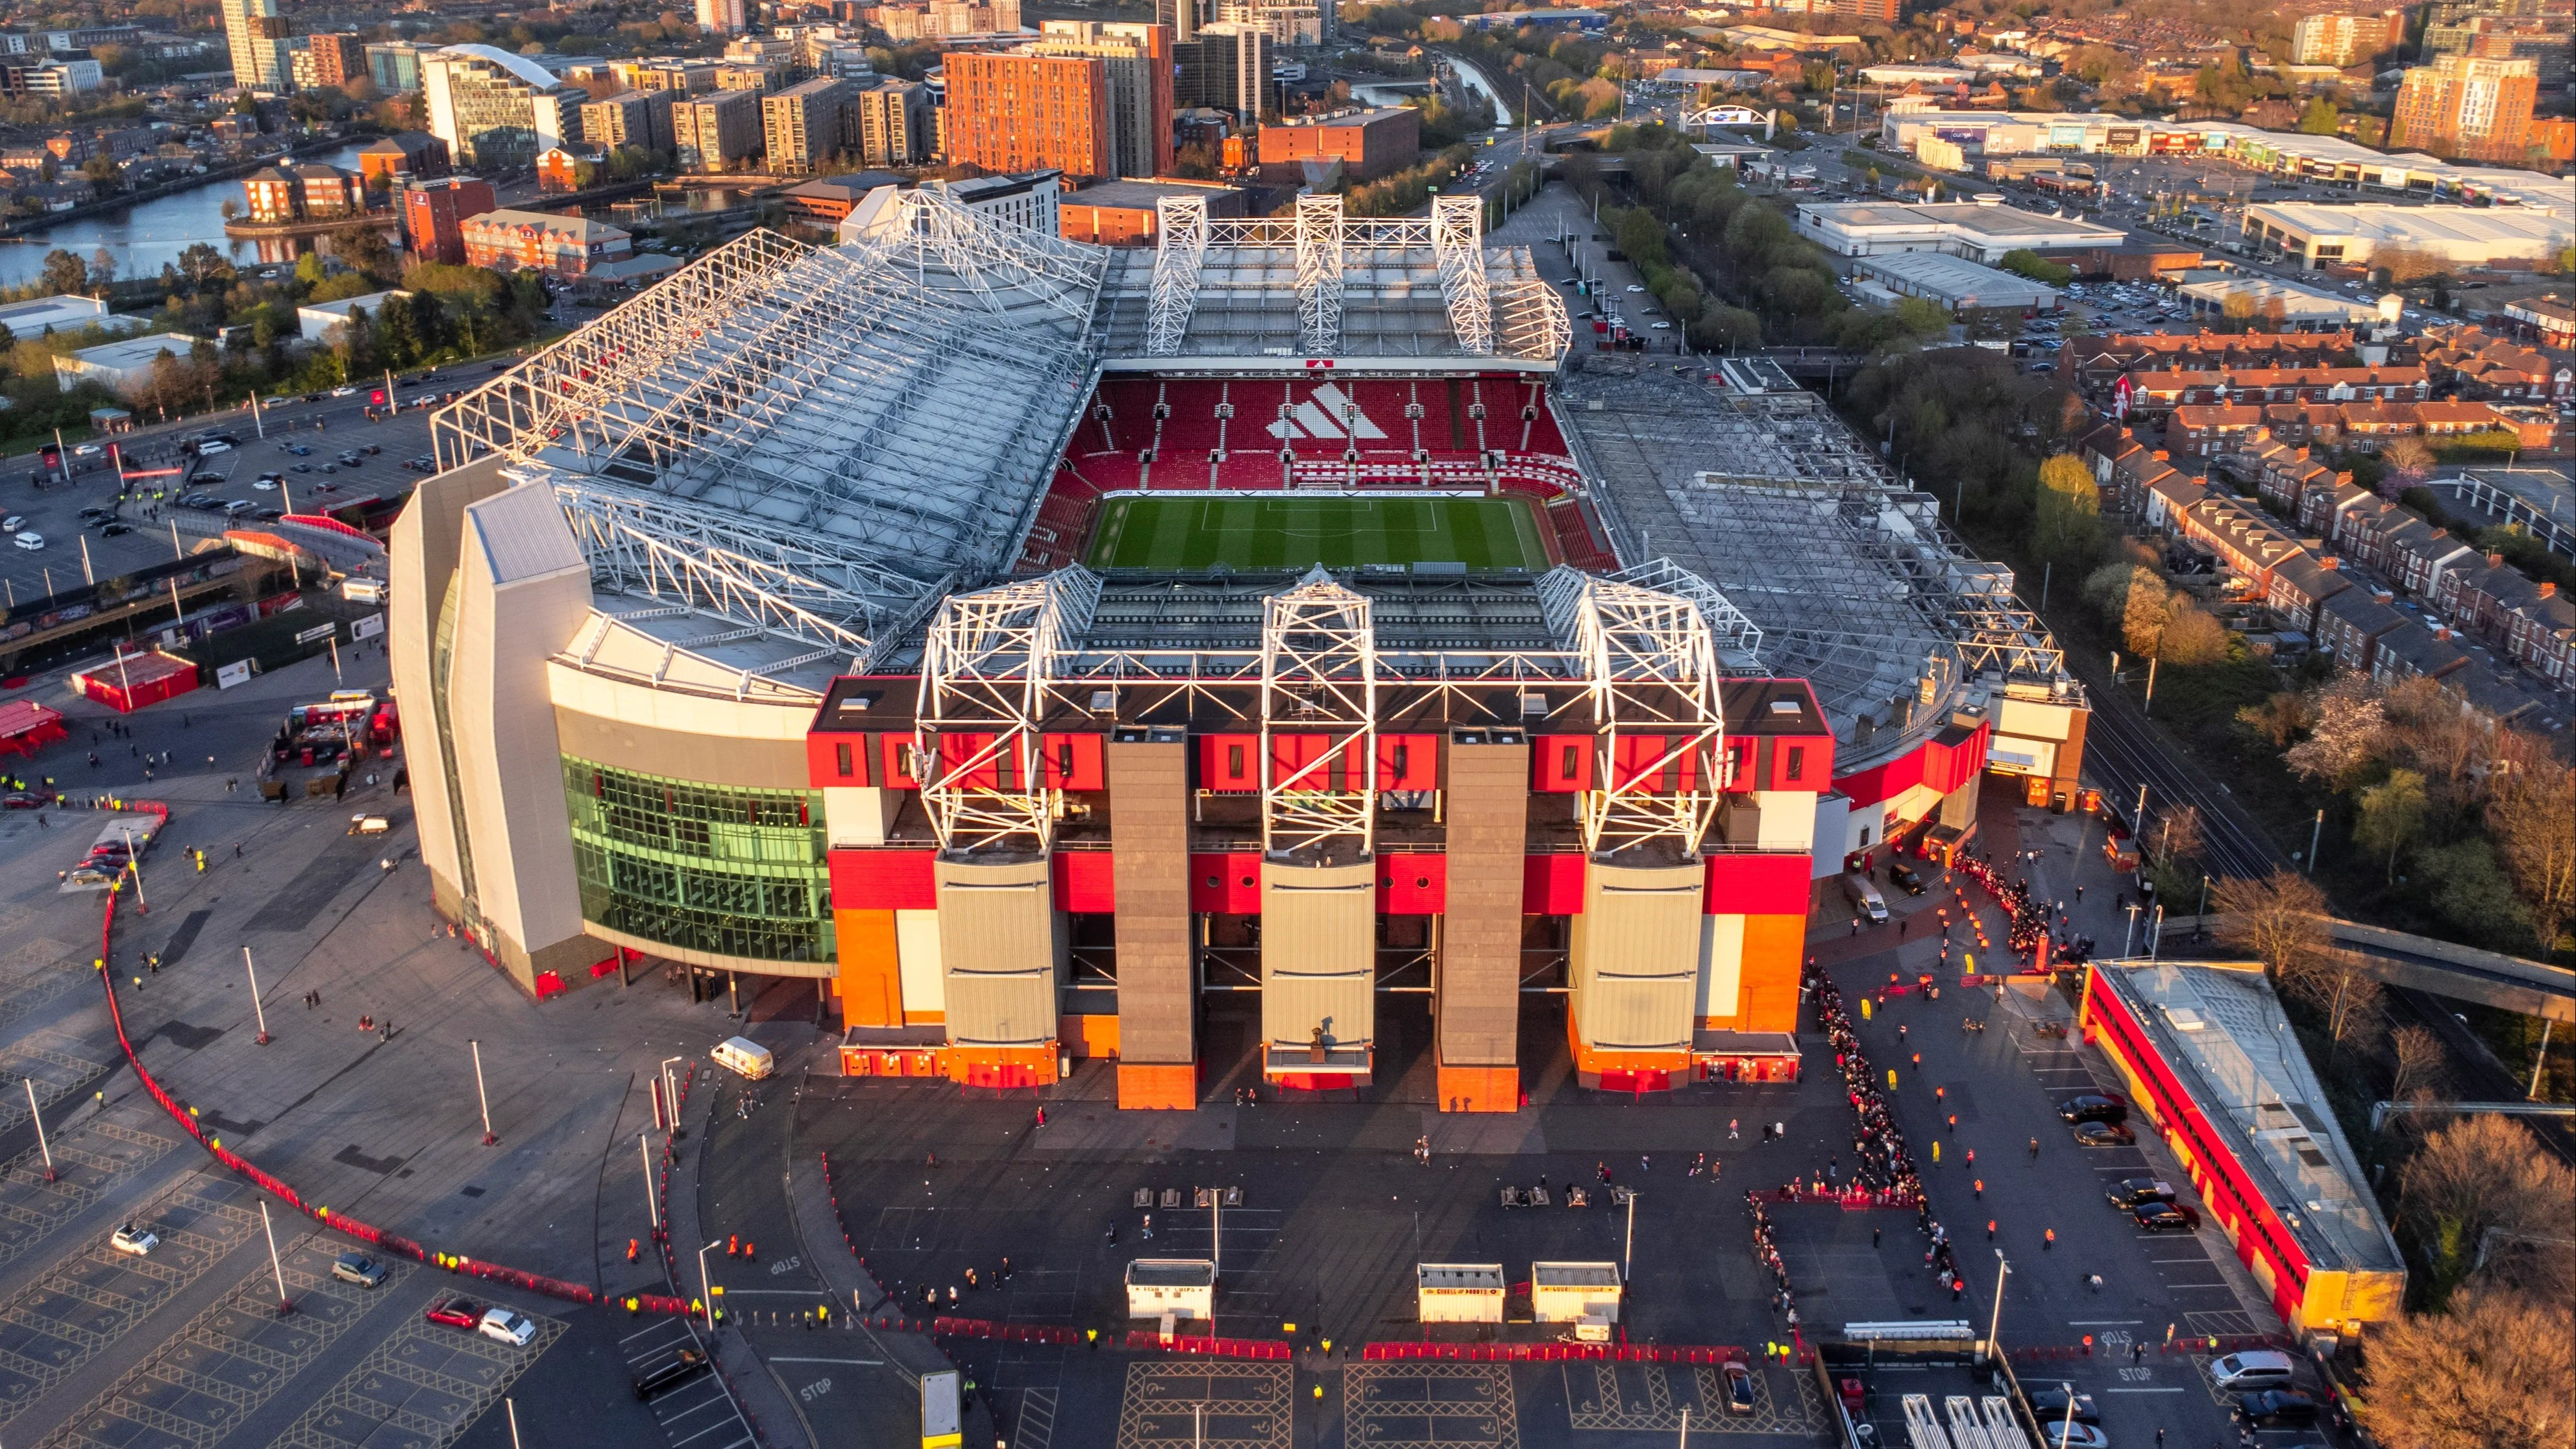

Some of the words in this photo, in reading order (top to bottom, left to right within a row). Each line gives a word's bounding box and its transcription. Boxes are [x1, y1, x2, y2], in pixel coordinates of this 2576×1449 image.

[771, 1256, 801, 1274] STOP
[2101, 1330, 2132, 1344] STOP
[2118, 1367, 2152, 1381] STOP
[801, 1378, 831, 1401] STOP
